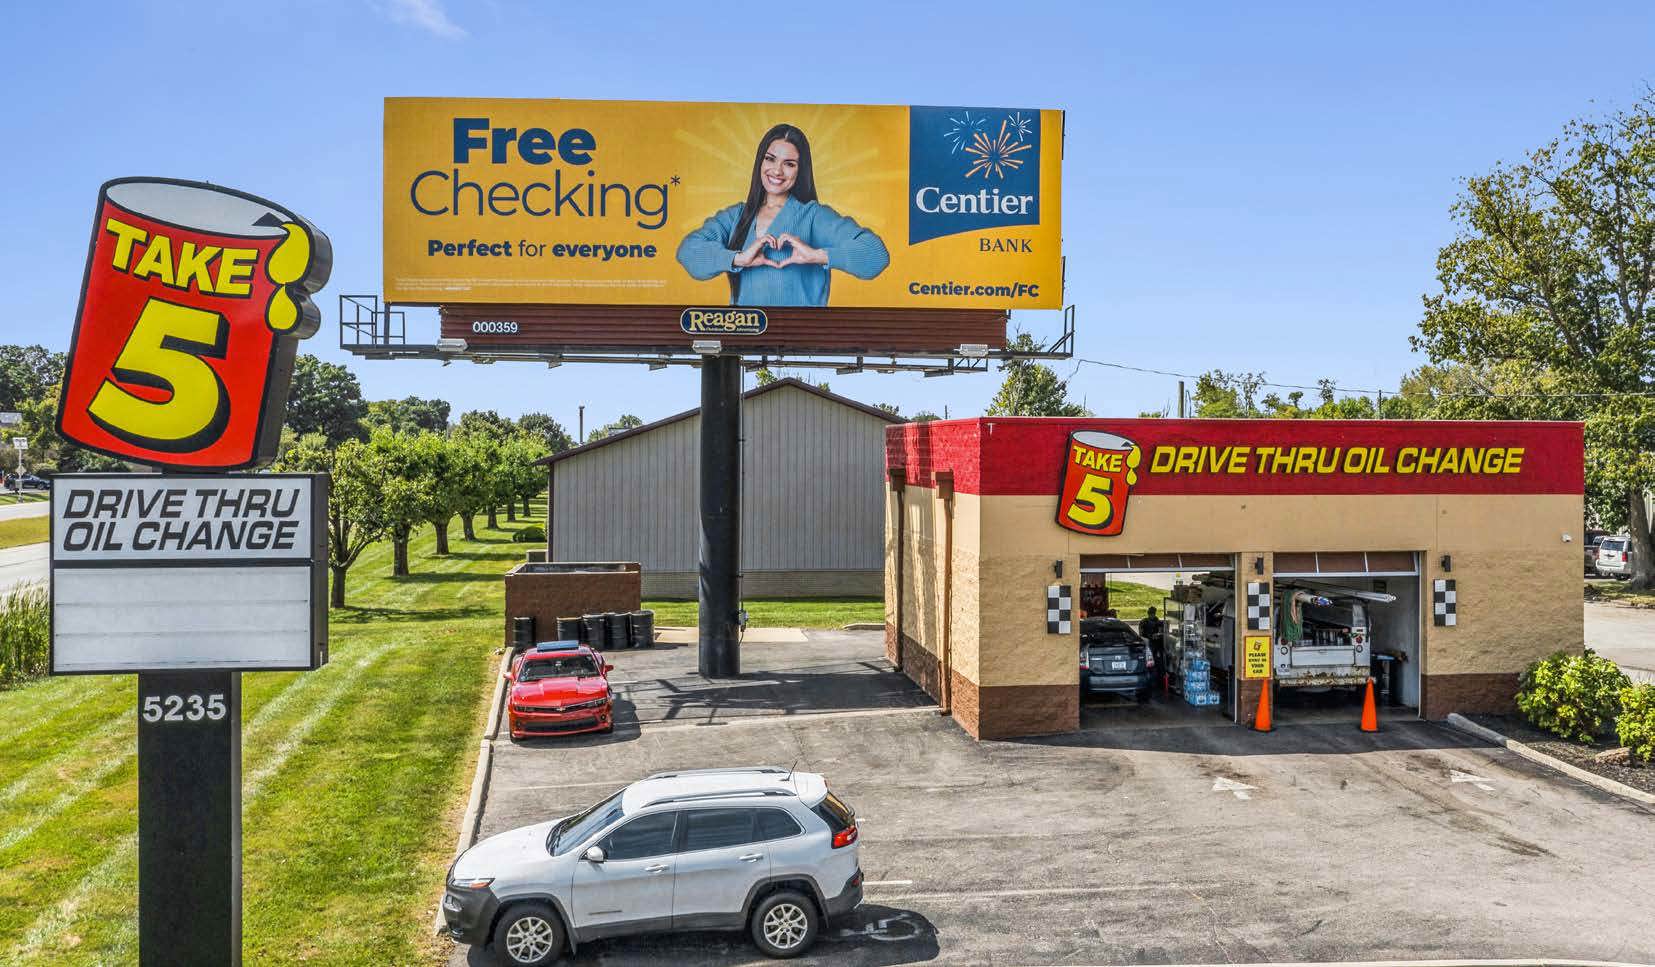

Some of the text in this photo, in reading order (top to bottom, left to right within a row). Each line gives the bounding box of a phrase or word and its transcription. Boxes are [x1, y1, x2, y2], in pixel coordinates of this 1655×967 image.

[453, 117, 597, 165] Free
[916, 186, 1034, 215] Centier
[106, 217, 260, 298] TAKE
[428, 239, 657, 262] Perfect for everyone
[979, 238, 1033, 252] BANK
[908, 281, 1040, 298] Centier.com/FC
[472, 321, 519, 333] 000359
[689, 311, 760, 332] Reagan
[88, 297, 228, 450] 5
[1073, 446, 1123, 473] TAKE
[1150, 446, 1525, 474] DRIVE THRU OIL CHANGE
[63, 488, 300, 519] DRIVE THRU
[1067, 473, 1114, 529] 5
[63, 520, 300, 551] OIL CHANGE
[142, 694, 227, 722] 5235
